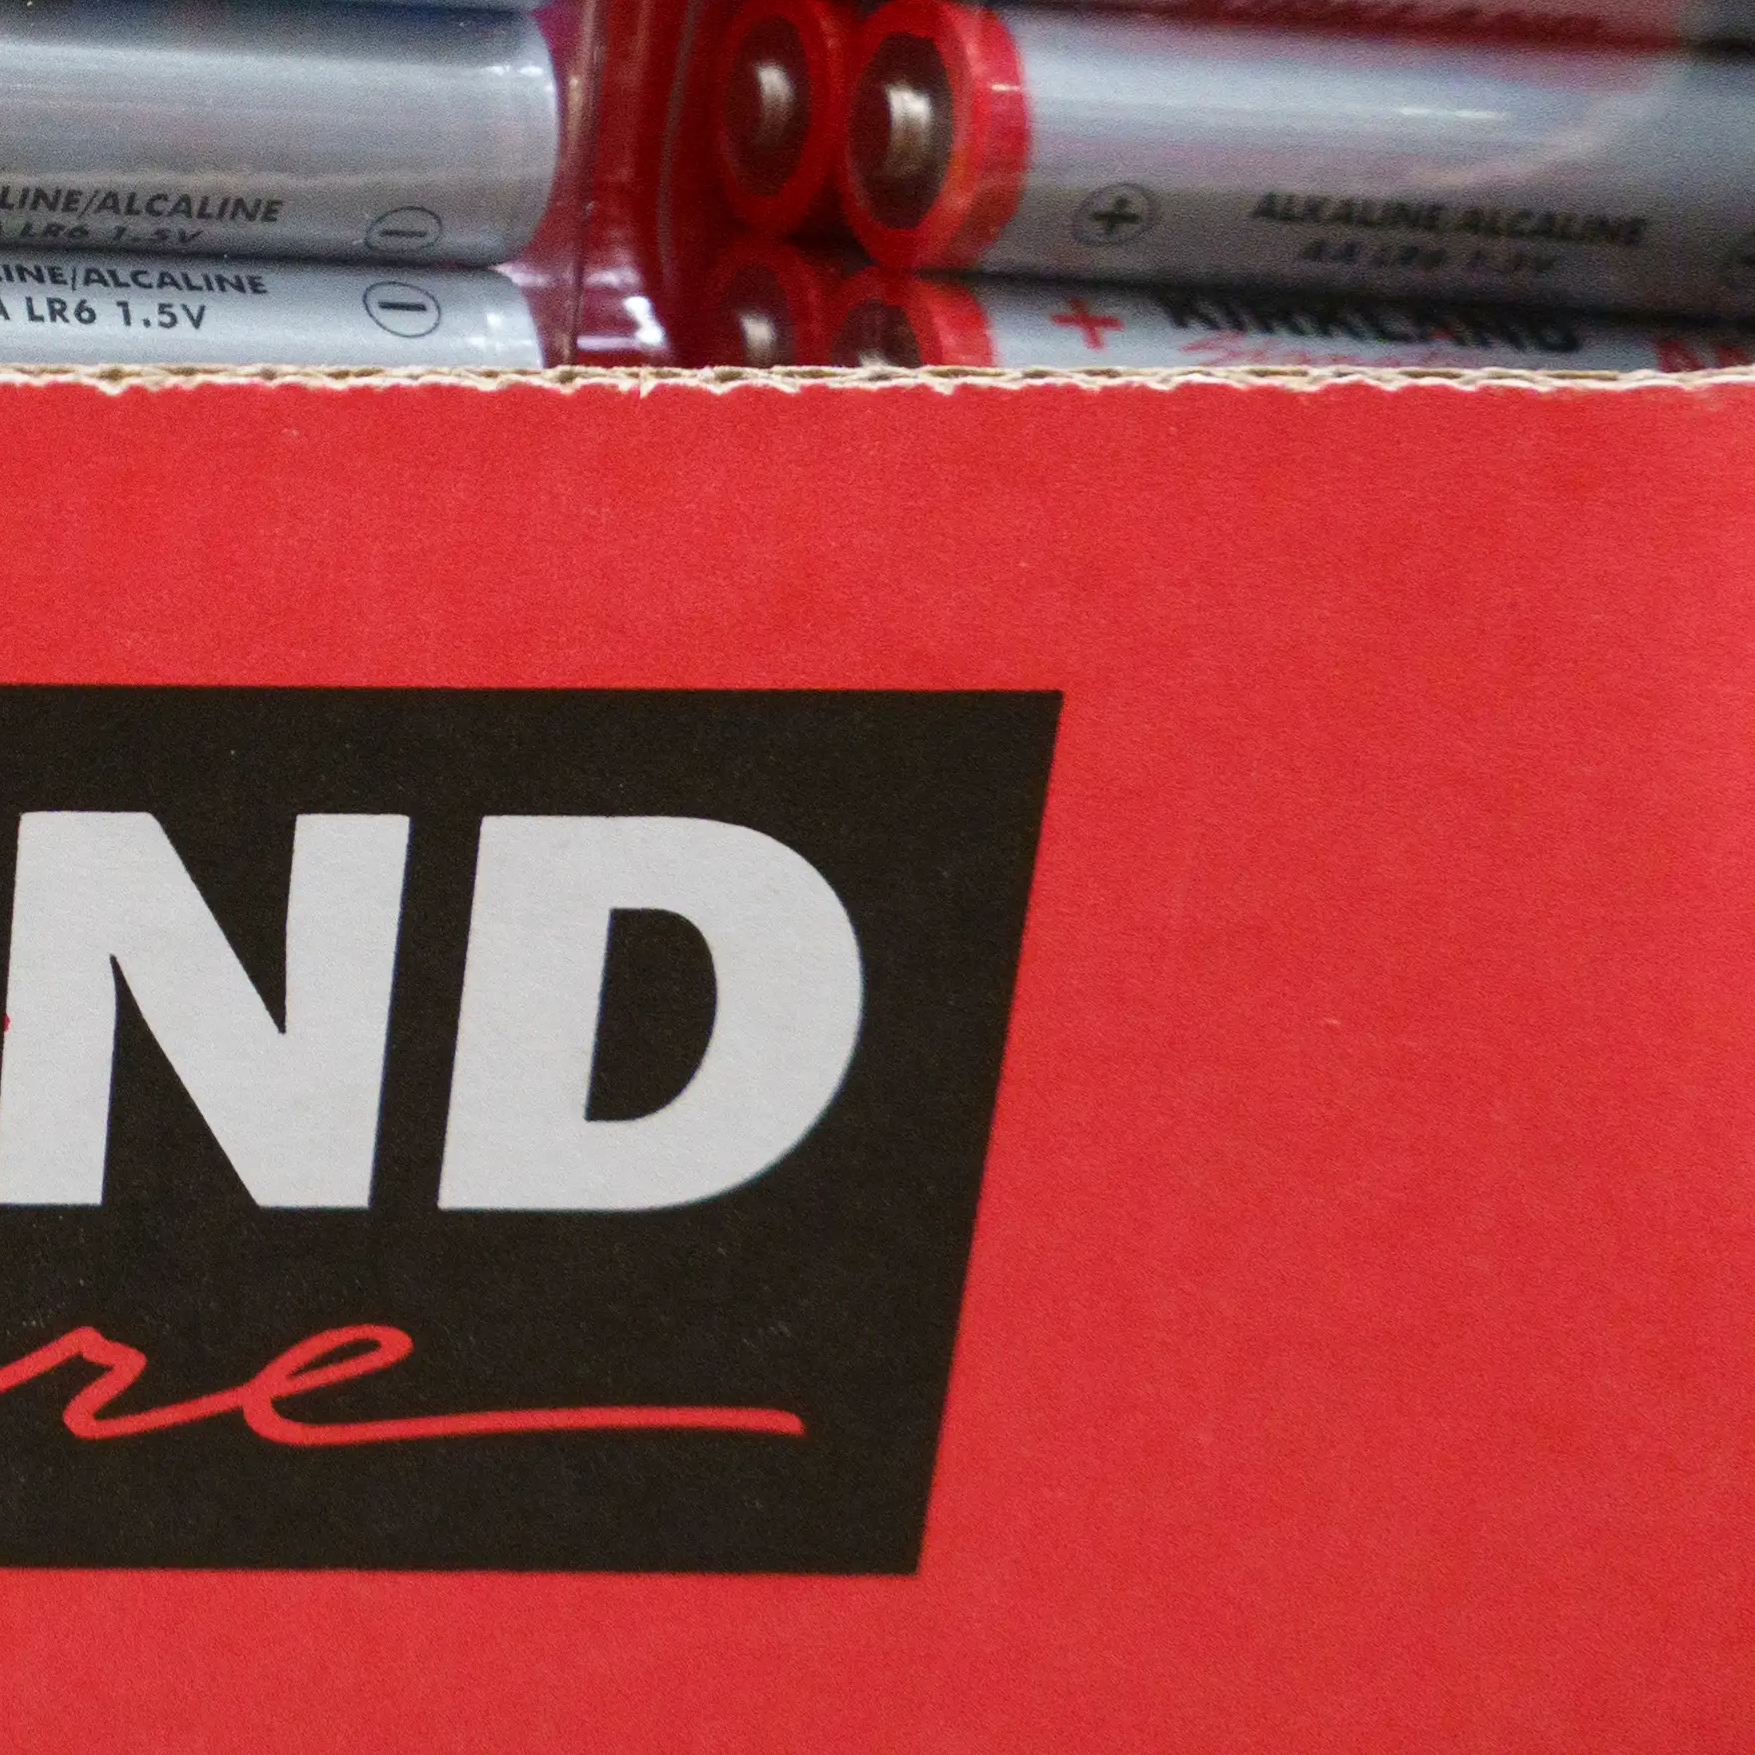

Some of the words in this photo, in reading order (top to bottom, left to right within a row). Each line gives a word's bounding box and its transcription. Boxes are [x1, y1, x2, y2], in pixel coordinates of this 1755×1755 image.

[22, 221, 90, 240] LR6
[111, 225, 206, 244] 1.5V
[27, 296, 97, 325] LR6
[116, 300, 207, 330] 1.5V
